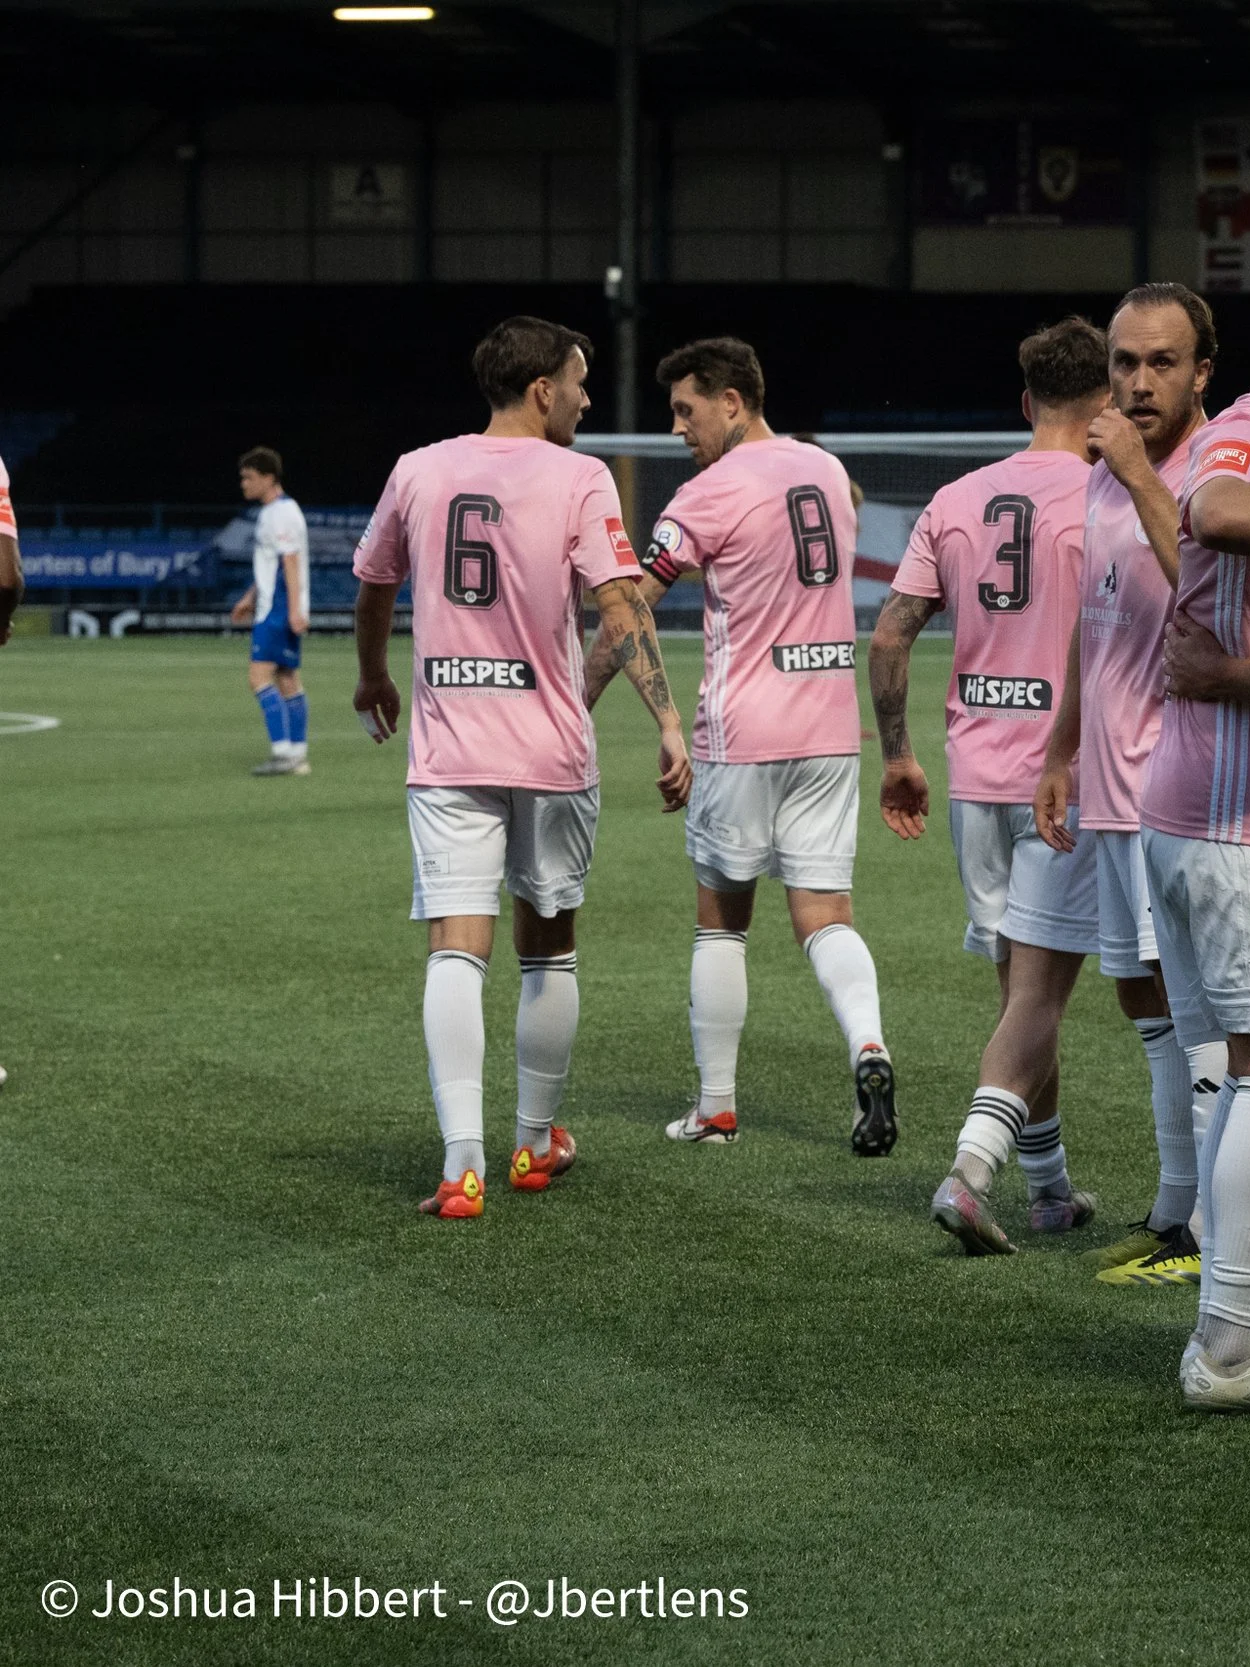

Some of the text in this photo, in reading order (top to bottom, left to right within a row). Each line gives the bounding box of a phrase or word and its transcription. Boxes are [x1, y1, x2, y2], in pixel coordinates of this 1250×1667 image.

[356, 166, 383, 194] A
[444, 493, 504, 610] 6
[786, 485, 843, 590] 8
[22, 554, 86, 577] orters
[90, 550, 115, 577] of
[117, 551, 171, 582] Bury
[978, 494, 1037, 614] 3
[432, 657, 525, 688] HiSPEC
[965, 675, 1043, 707] HiSPEC
